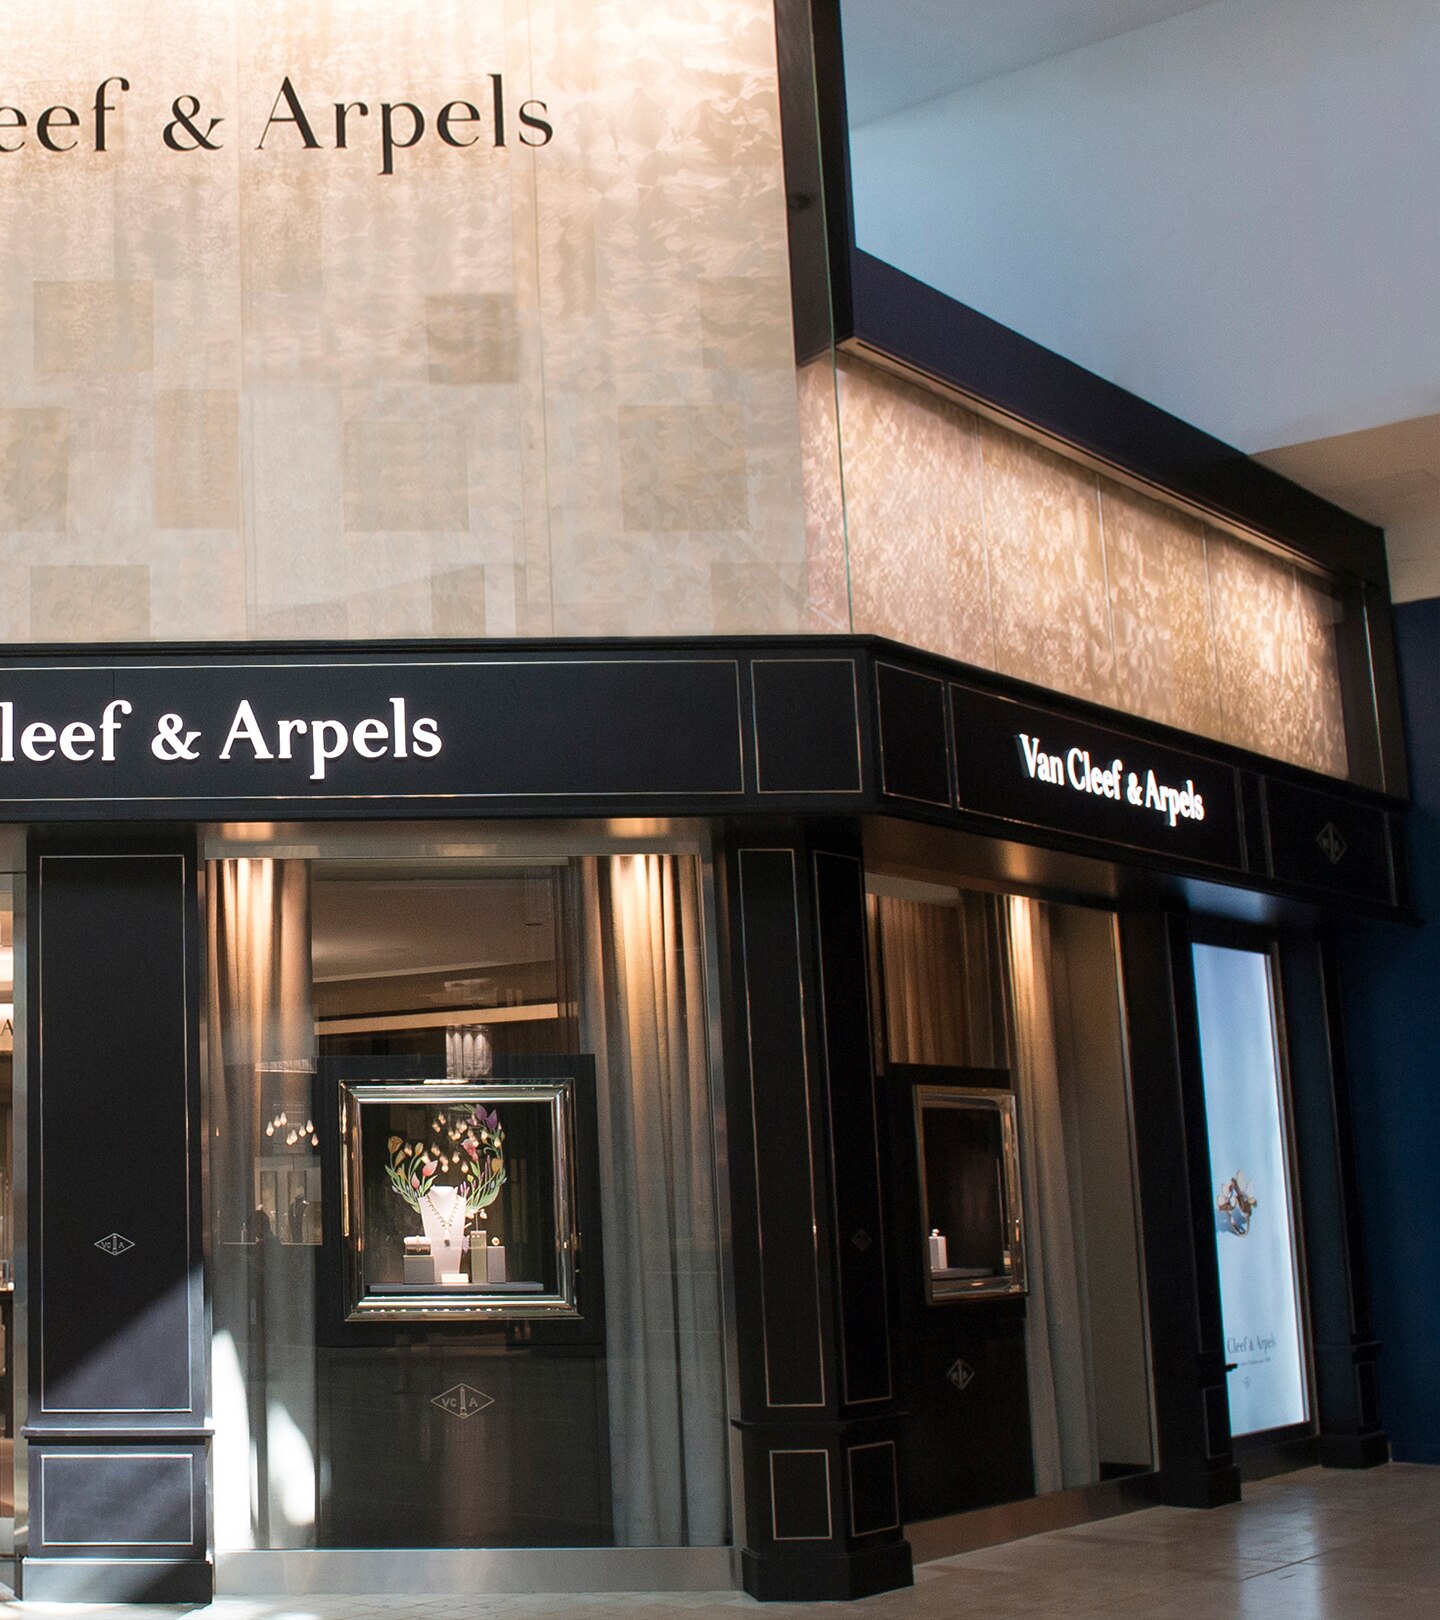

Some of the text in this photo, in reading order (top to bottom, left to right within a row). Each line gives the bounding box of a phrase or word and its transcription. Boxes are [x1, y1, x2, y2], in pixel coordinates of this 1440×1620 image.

[162, 95, 224, 152] &
[255, 73, 554, 175] Arpels
[150, 713, 202, 761] &
[218, 697, 443, 780] Arpels
[1018, 733, 1205, 828] Van Cleef & Arpels
